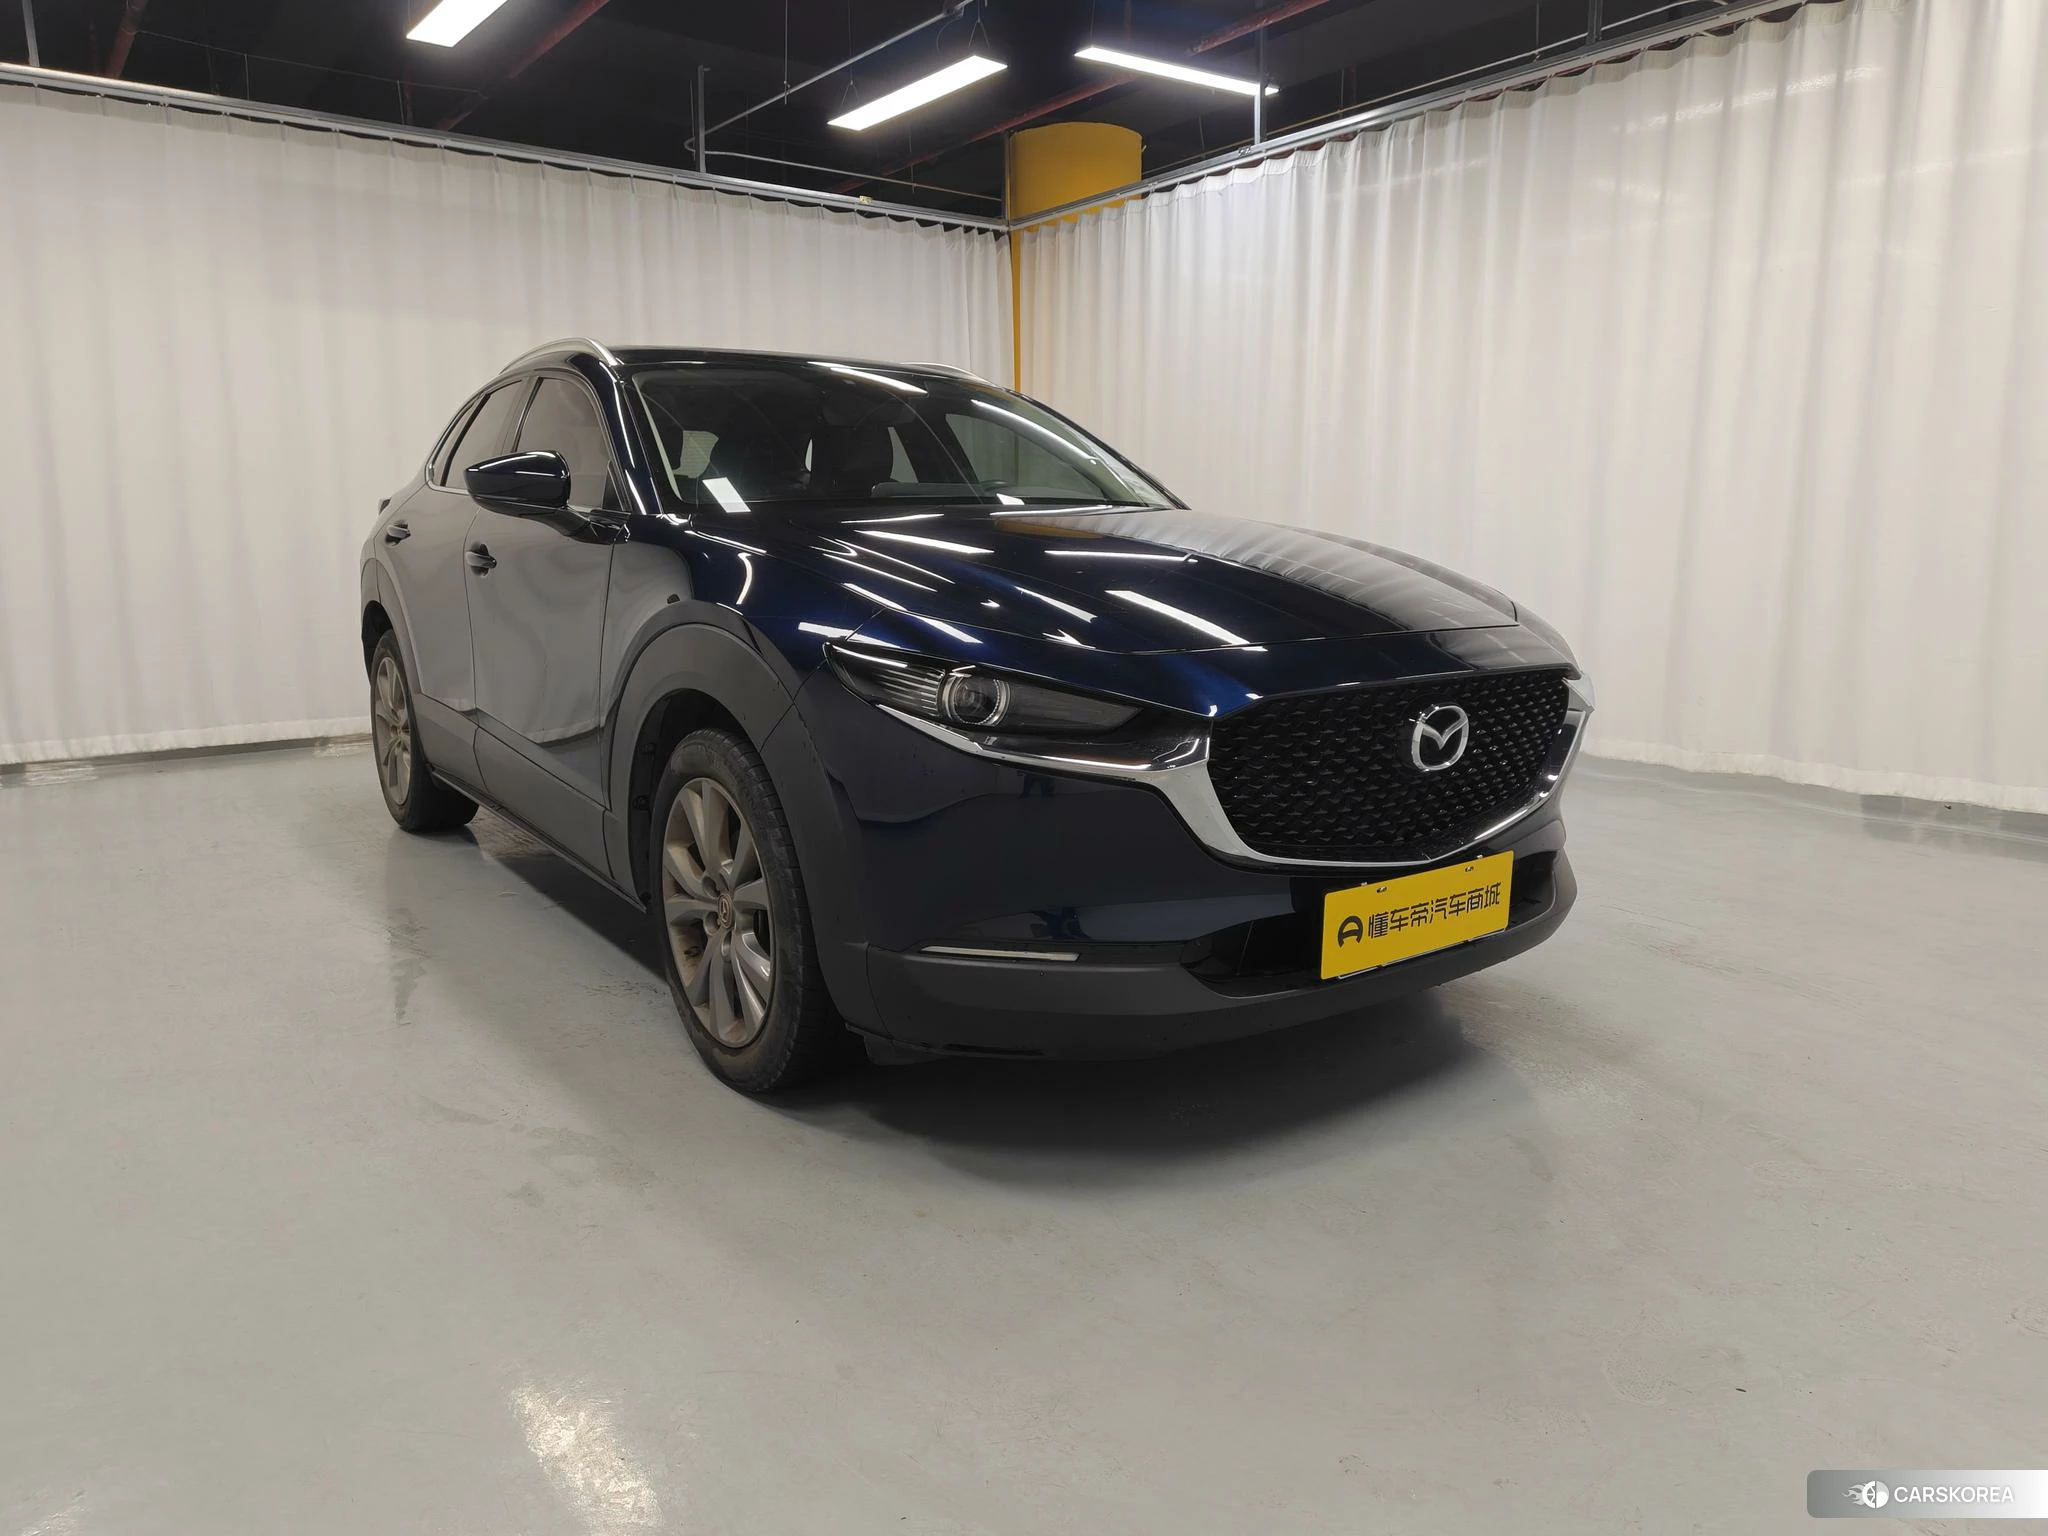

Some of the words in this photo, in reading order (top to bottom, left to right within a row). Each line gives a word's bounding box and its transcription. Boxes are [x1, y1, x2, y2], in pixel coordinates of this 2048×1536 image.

[1368, 882, 1501, 938] 懂车帝汽车商城
